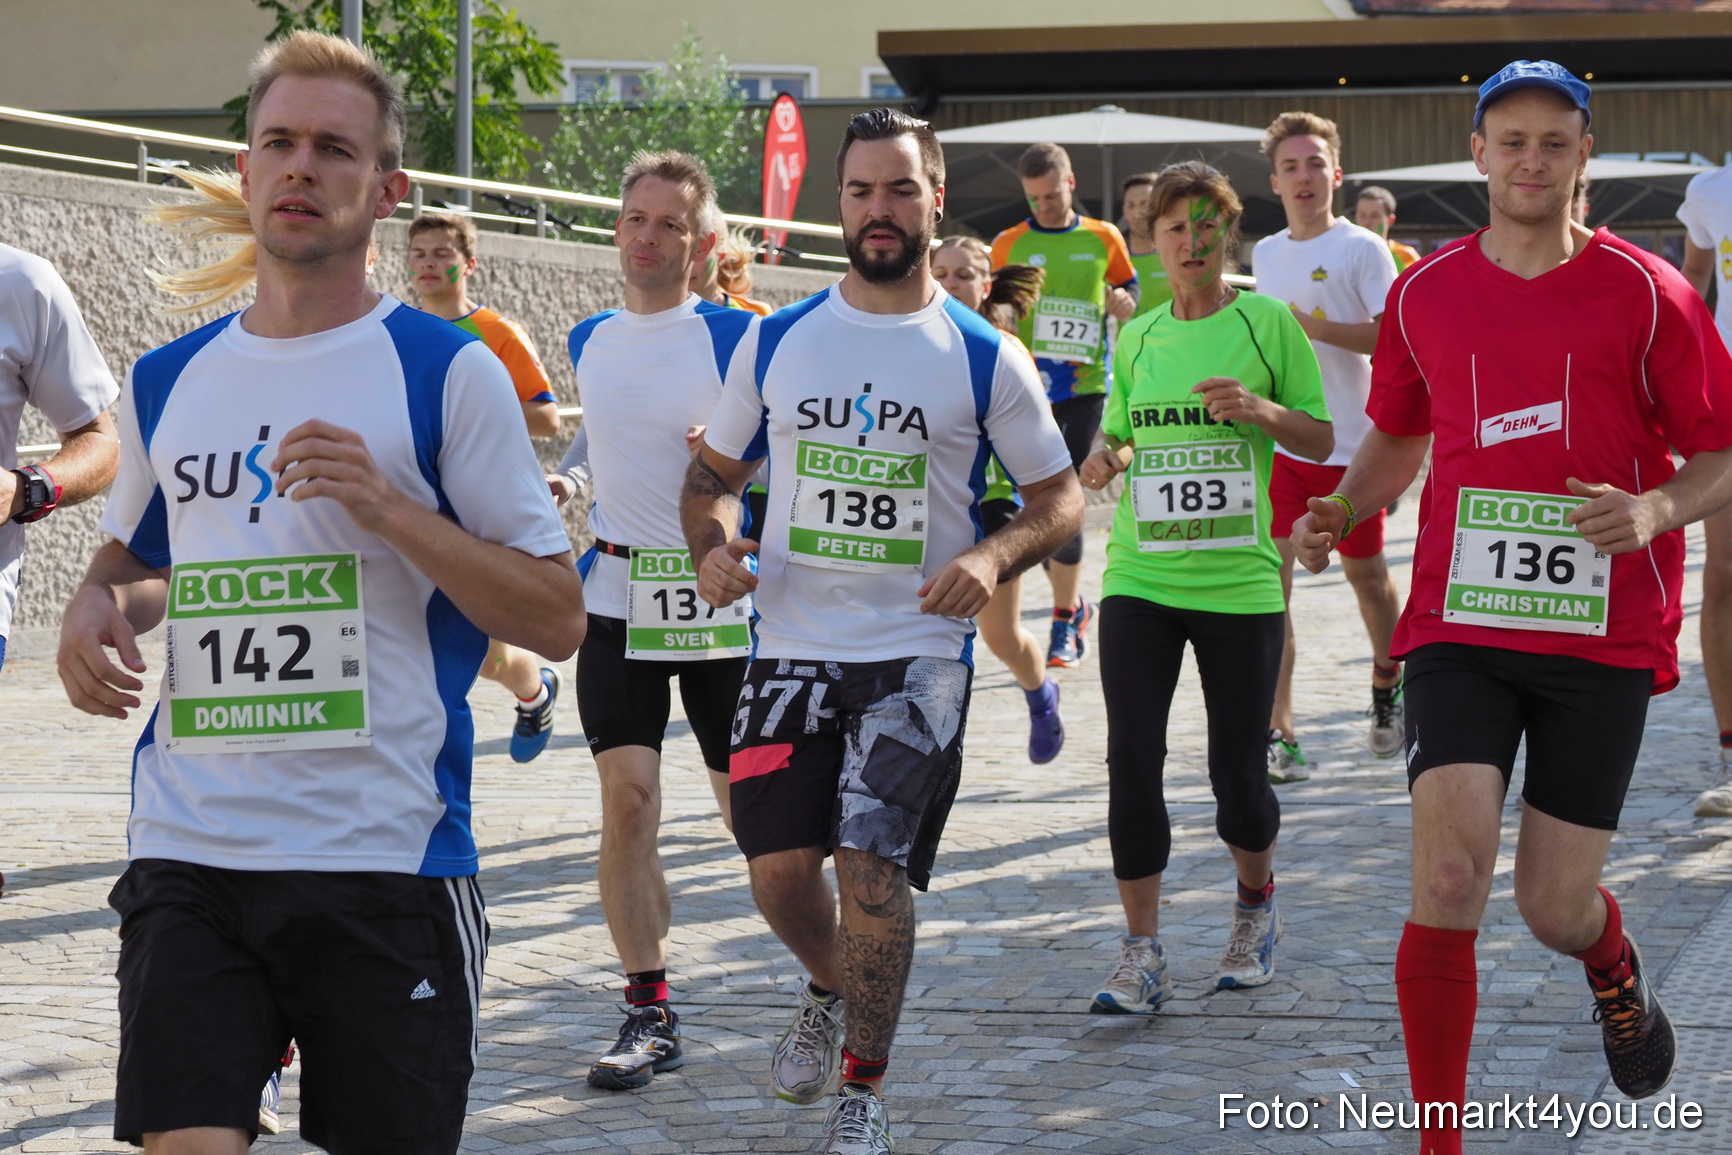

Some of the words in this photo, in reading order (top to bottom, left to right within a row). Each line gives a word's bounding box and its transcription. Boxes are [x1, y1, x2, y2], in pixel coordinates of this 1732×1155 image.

[1041, 300, 1097, 320] BOCK
[1051, 321, 1088, 339] 127
[797, 383, 929, 446] SUSPA
[1502, 414, 1540, 433] DEHN
[805, 445, 917, 485] BOCK
[1140, 444, 1244, 474] BOCK
[818, 488, 897, 530] 138
[913, 499, 923, 507] E6
[1158, 479, 1228, 513] 183
[817, 536, 887, 559] PETER
[1488, 540, 1576, 585] 136
[175, 562, 343, 612] BOCK
[1461, 590, 1591, 617] CHRISTIAN
[341, 627, 356, 636] E6
[664, 631, 715, 647] SVEN
[198, 624, 314, 685] 142
[195, 701, 328, 731] DOMINIK
[411, 988, 437, 1000] adidas
